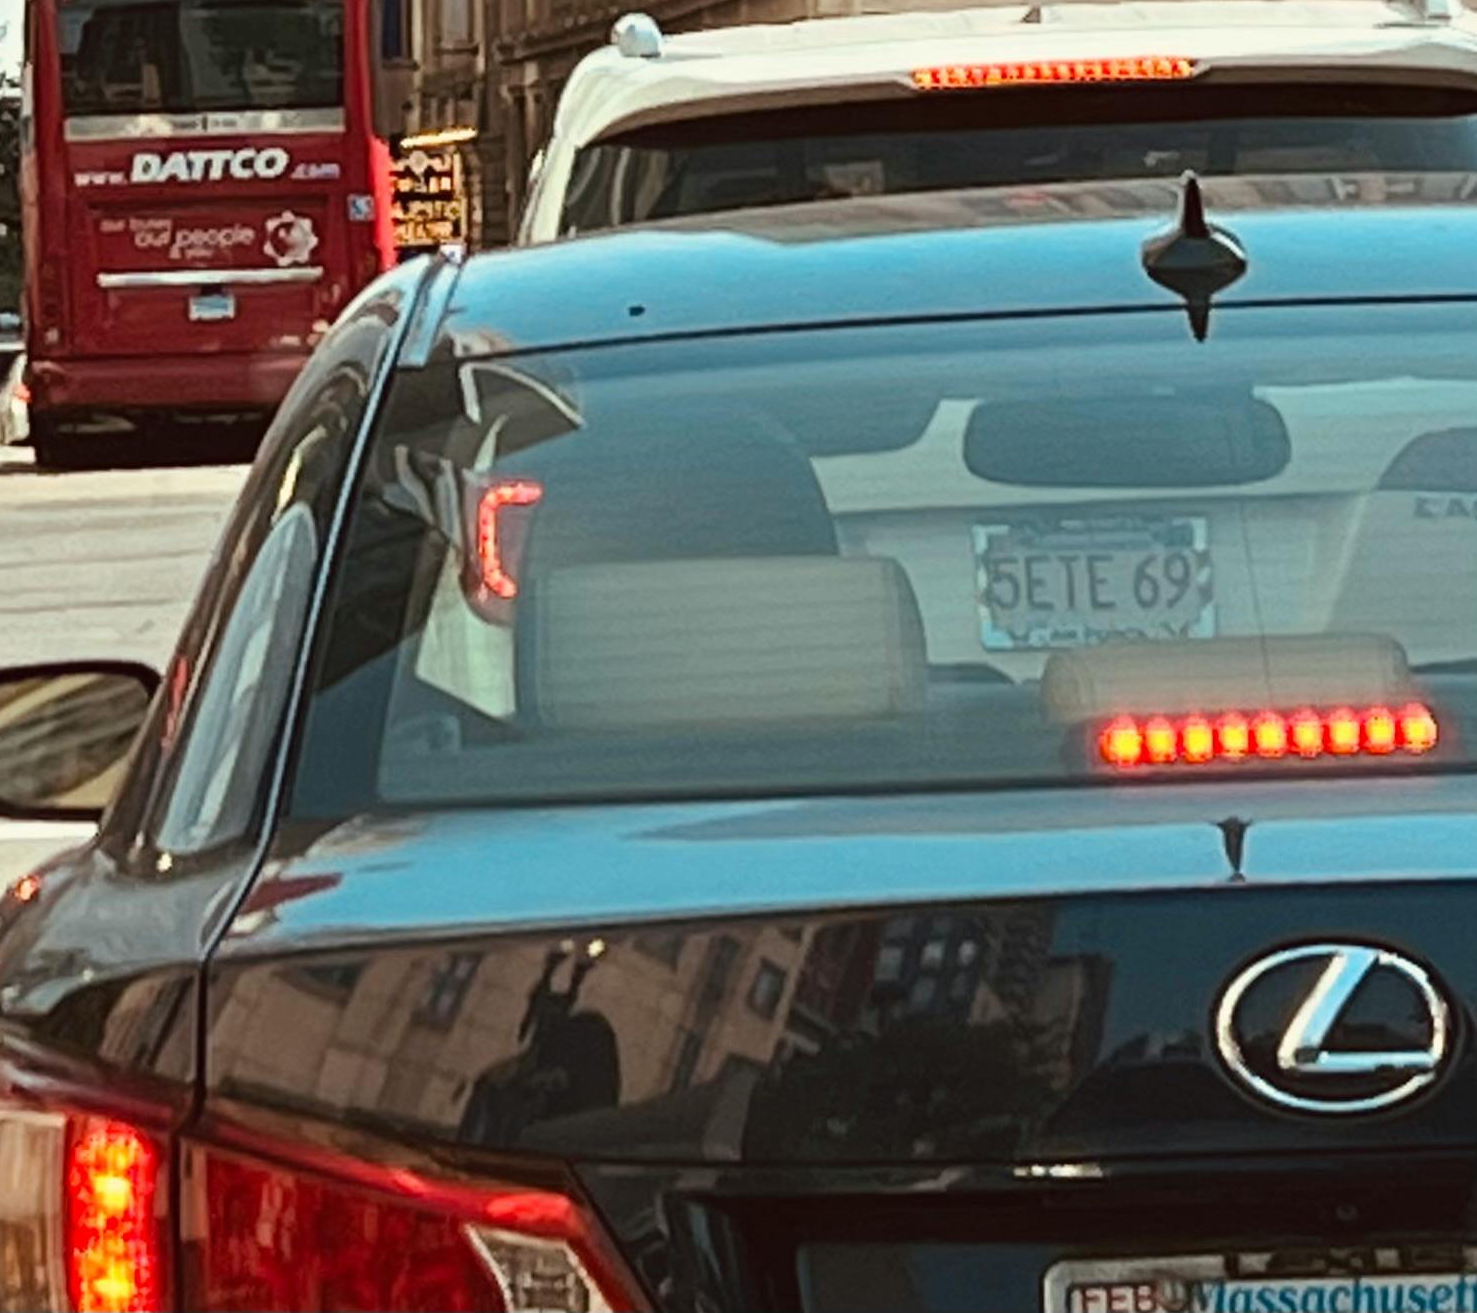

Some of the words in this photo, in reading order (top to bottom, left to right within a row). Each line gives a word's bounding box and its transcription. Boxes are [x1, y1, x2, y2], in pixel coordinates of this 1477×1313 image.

[175, 225, 256, 253] people
[986, 553, 1116, 611] 5ETE
[1132, 552, 1191, 610] 69
